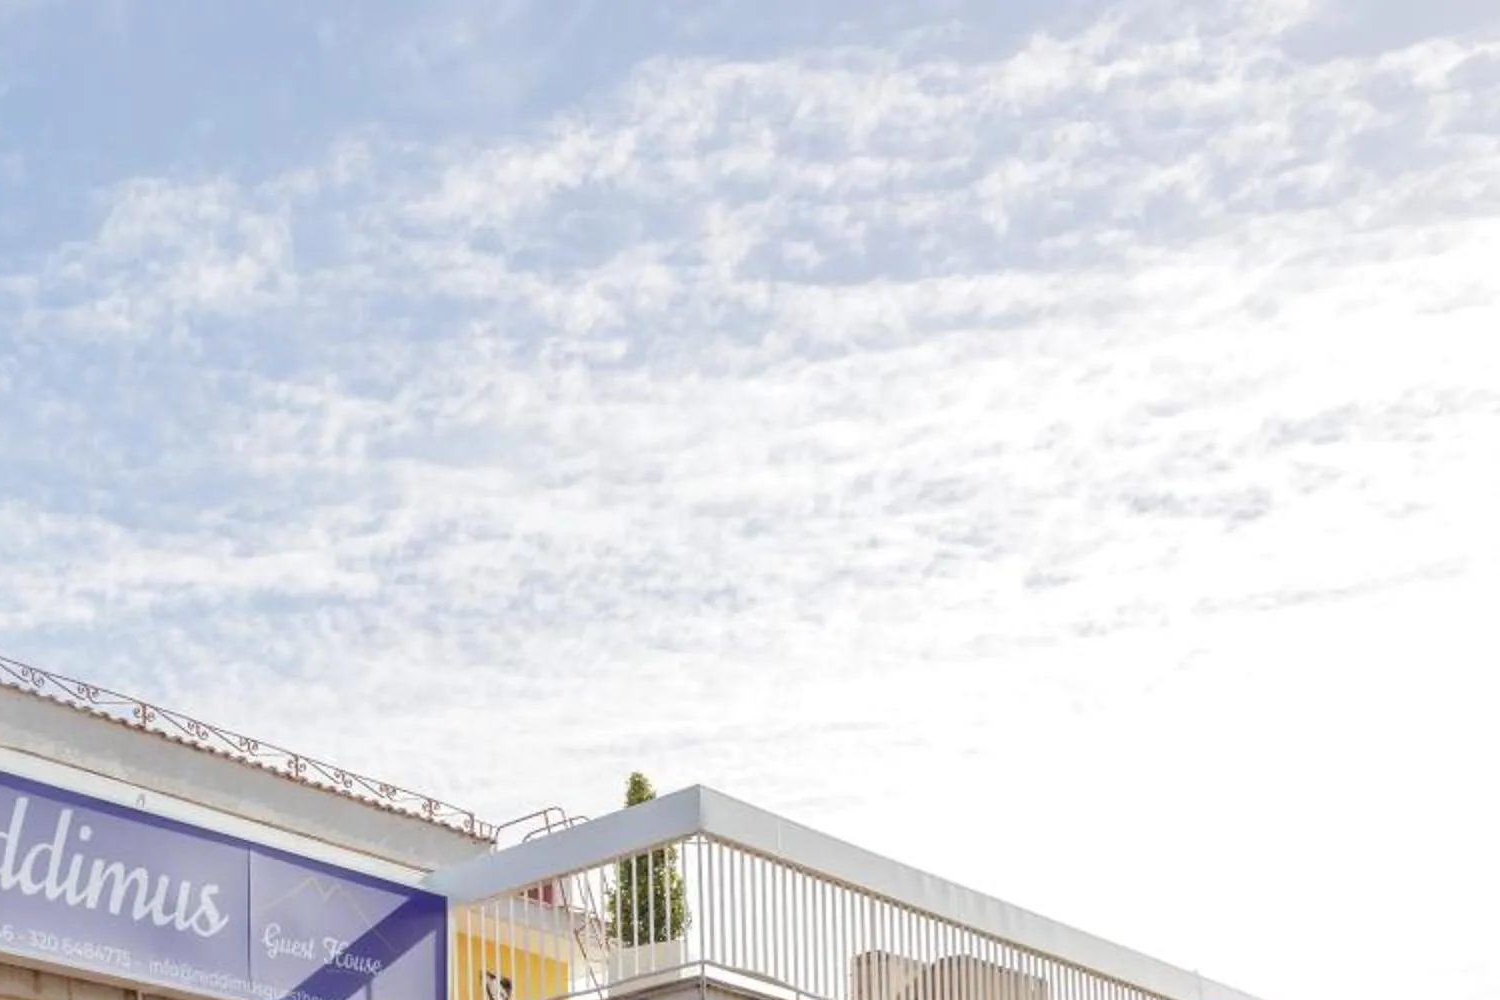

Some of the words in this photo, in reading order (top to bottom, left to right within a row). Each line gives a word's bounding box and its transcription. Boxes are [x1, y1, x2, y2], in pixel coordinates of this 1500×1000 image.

[27, 930, 59, 950] 320
[261, 923, 316, 960] Guest
[323, 937, 385, 975] House
